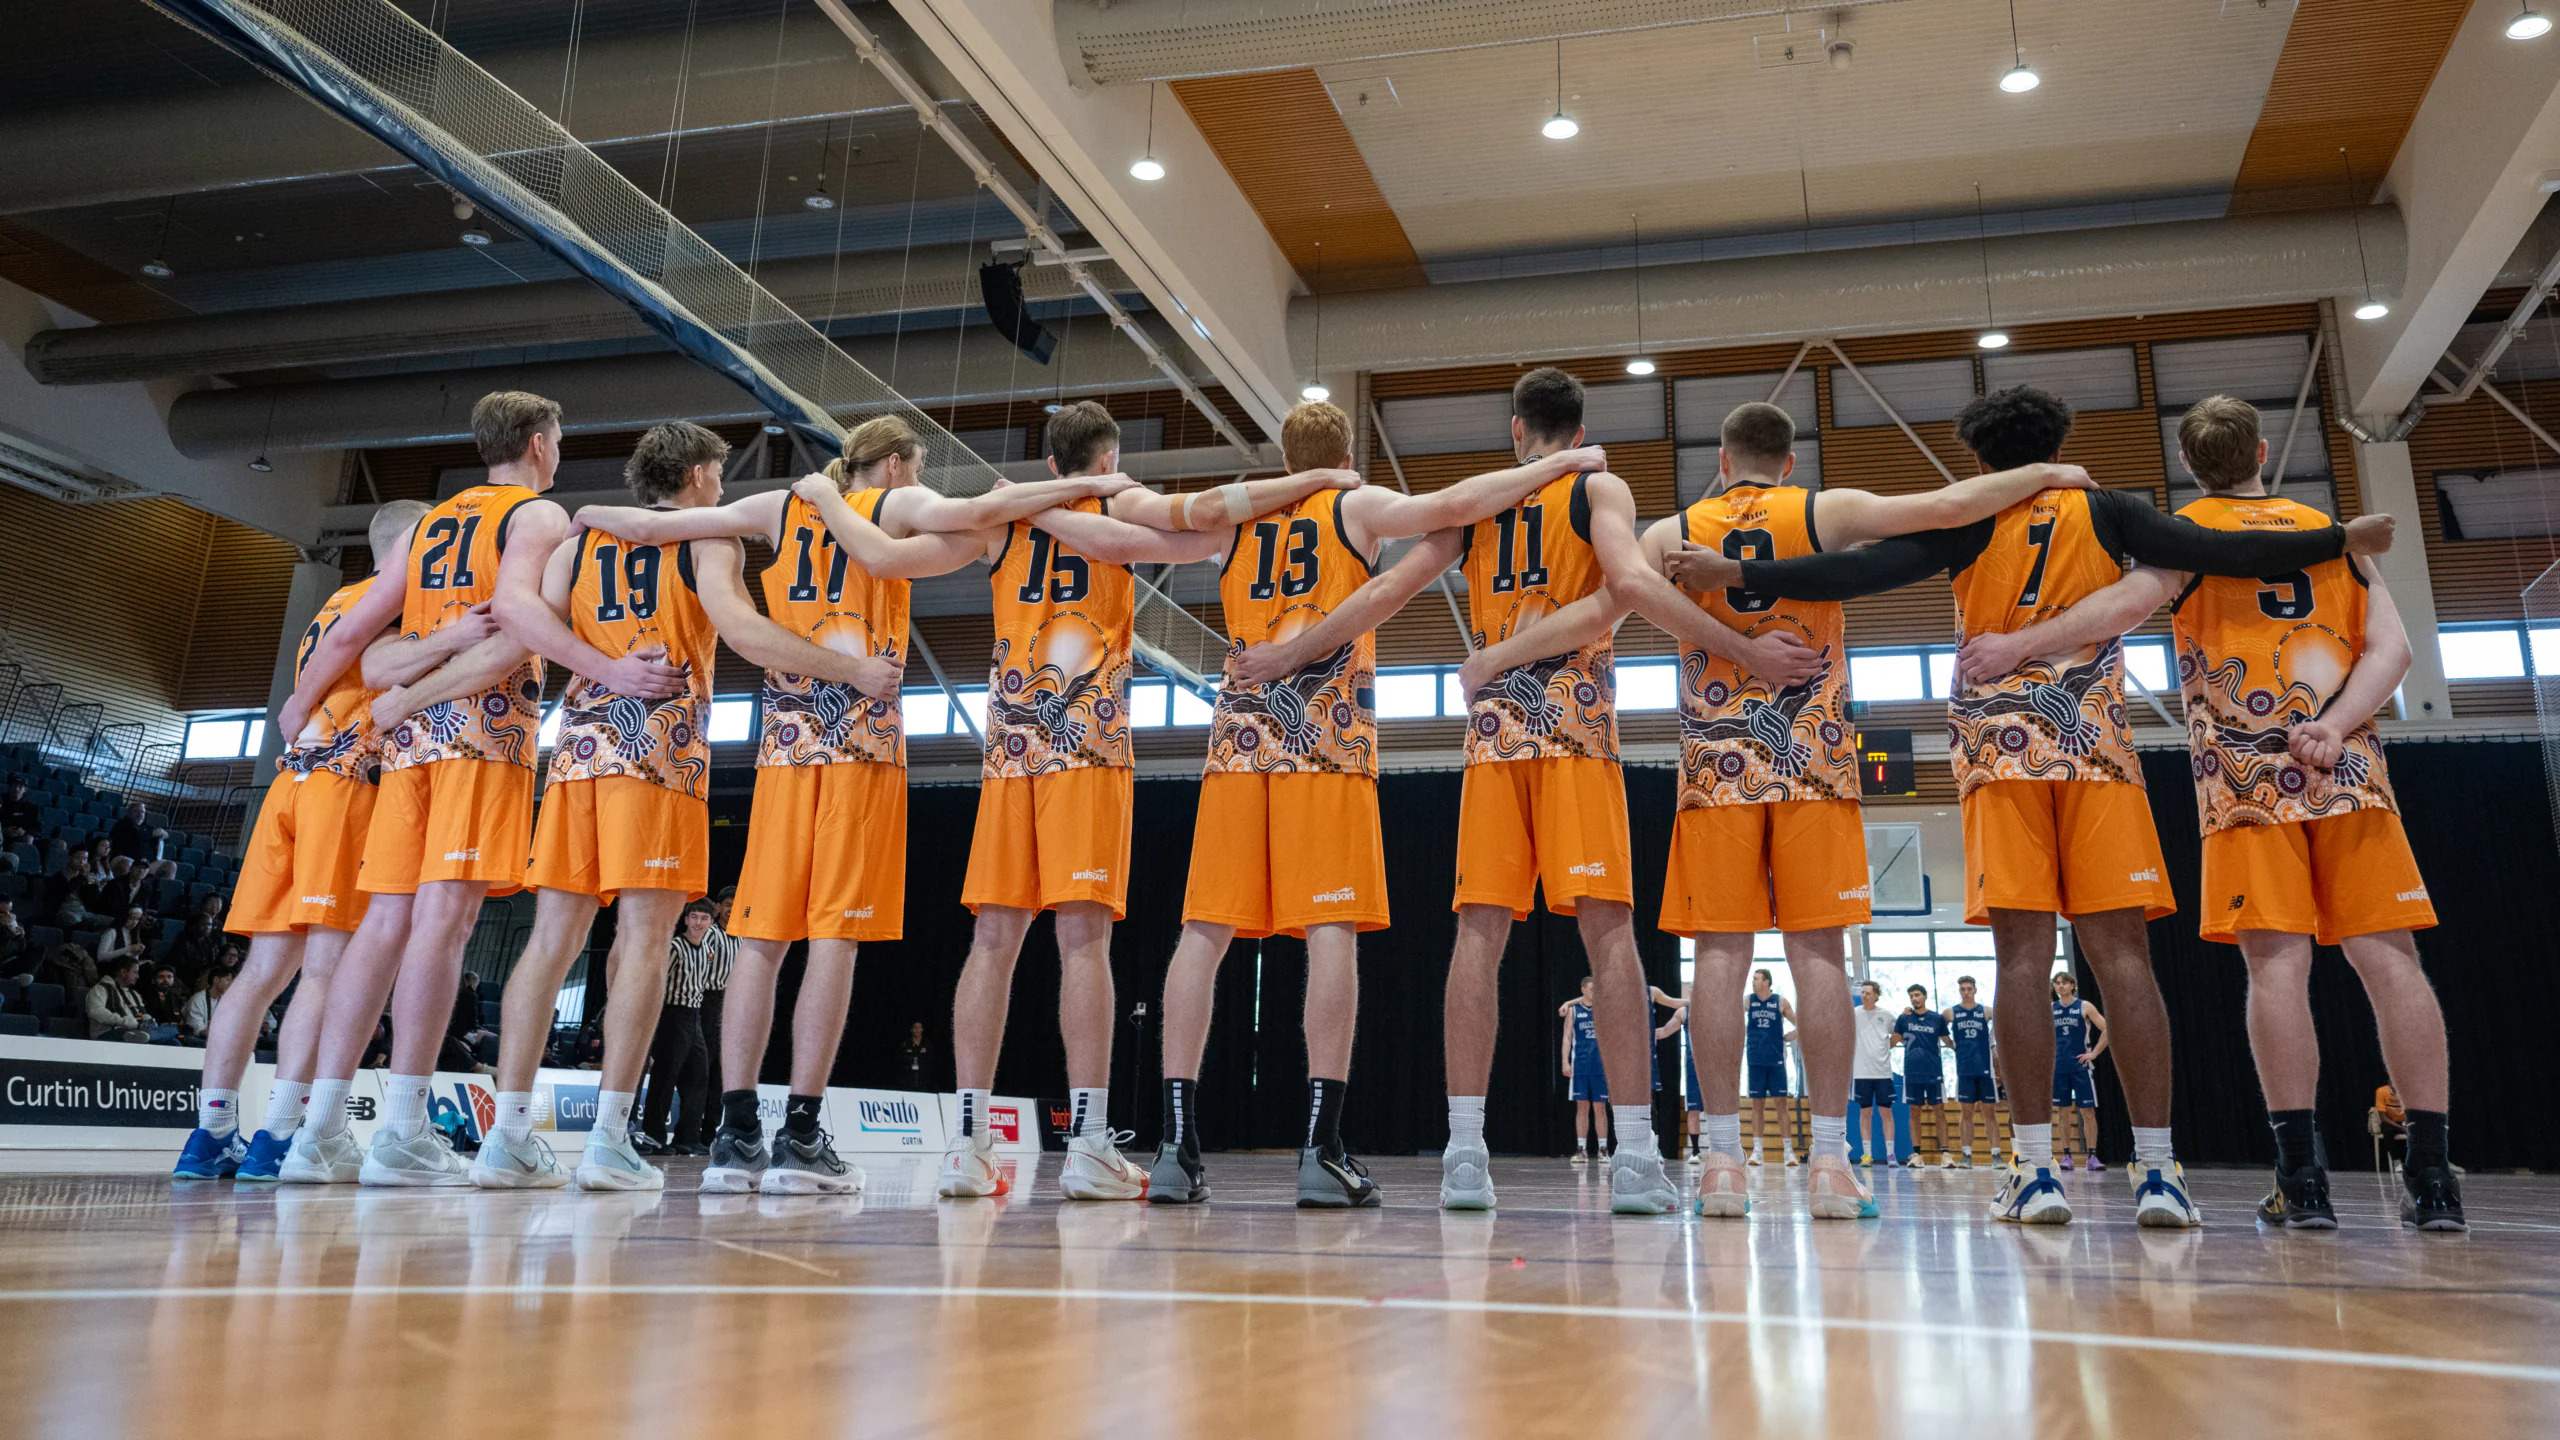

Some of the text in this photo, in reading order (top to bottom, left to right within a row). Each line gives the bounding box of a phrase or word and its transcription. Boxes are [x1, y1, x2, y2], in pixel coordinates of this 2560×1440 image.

[420, 514, 483, 590] 21
[1492, 503, 1548, 595] 11
[1249, 516, 1319, 599] 13
[788, 526, 849, 604] 17
[1018, 526, 1090, 604] 15
[594, 544, 662, 623] 19
[645, 857, 680, 869] unisport
[1569, 862, 1606, 877] unisport
[1072, 870, 1109, 883] unisport
[1313, 889, 1356, 903] unisport
[844, 908, 874, 920] unisport
[1751, 1009, 1776, 1020] FALCONS
[1757, 1018, 1770, 1028] 12
[1908, 1023, 1934, 1033] Falcons
[1957, 1020, 1983, 1030] FALCONS
[1965, 1028, 1977, 1038] 19
[2062, 1026, 2070, 1036] 3
[6, 1076, 202, 1112] Curtin Universit
[560, 1096, 598, 1119] Curti
[858, 1095, 919, 1124] nesuto
[990, 1112, 1017, 1126] SLINK
[902, 1136, 923, 1146] CURTIN
